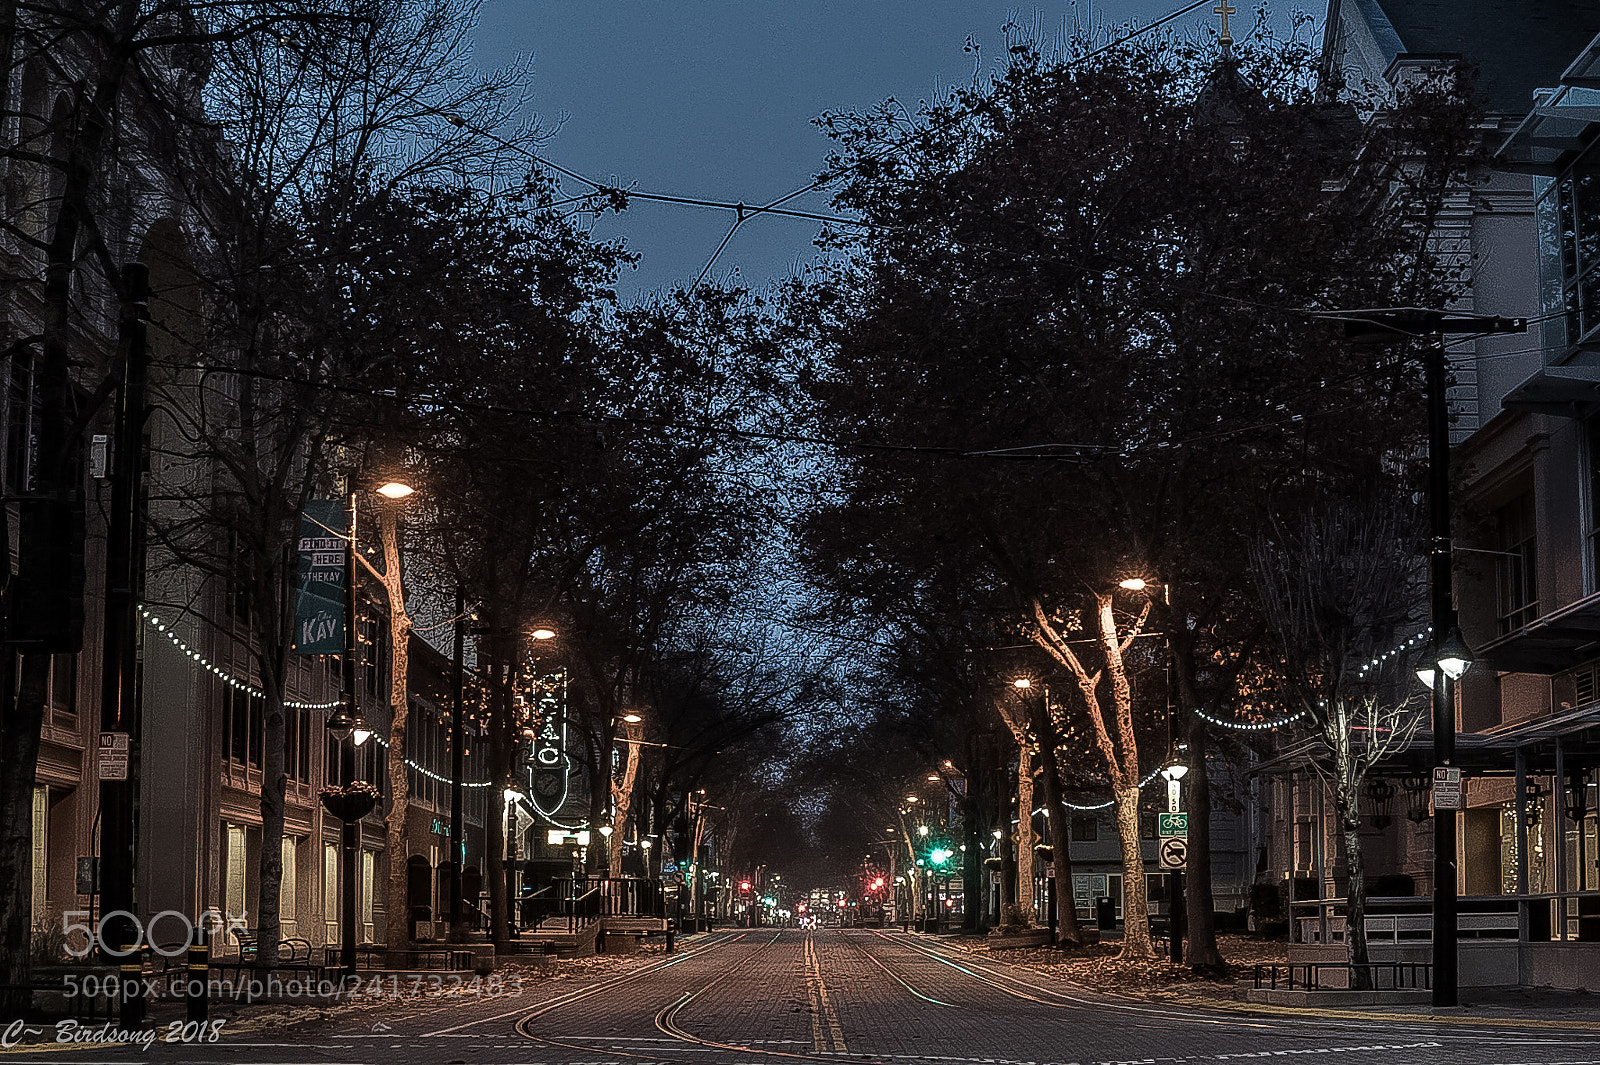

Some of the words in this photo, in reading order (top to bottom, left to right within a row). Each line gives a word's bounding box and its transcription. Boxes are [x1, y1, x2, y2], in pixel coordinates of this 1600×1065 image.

[316, 554, 340, 565] HERE
[302, 618, 337, 645] KAY
[101, 735, 112, 746] NO
